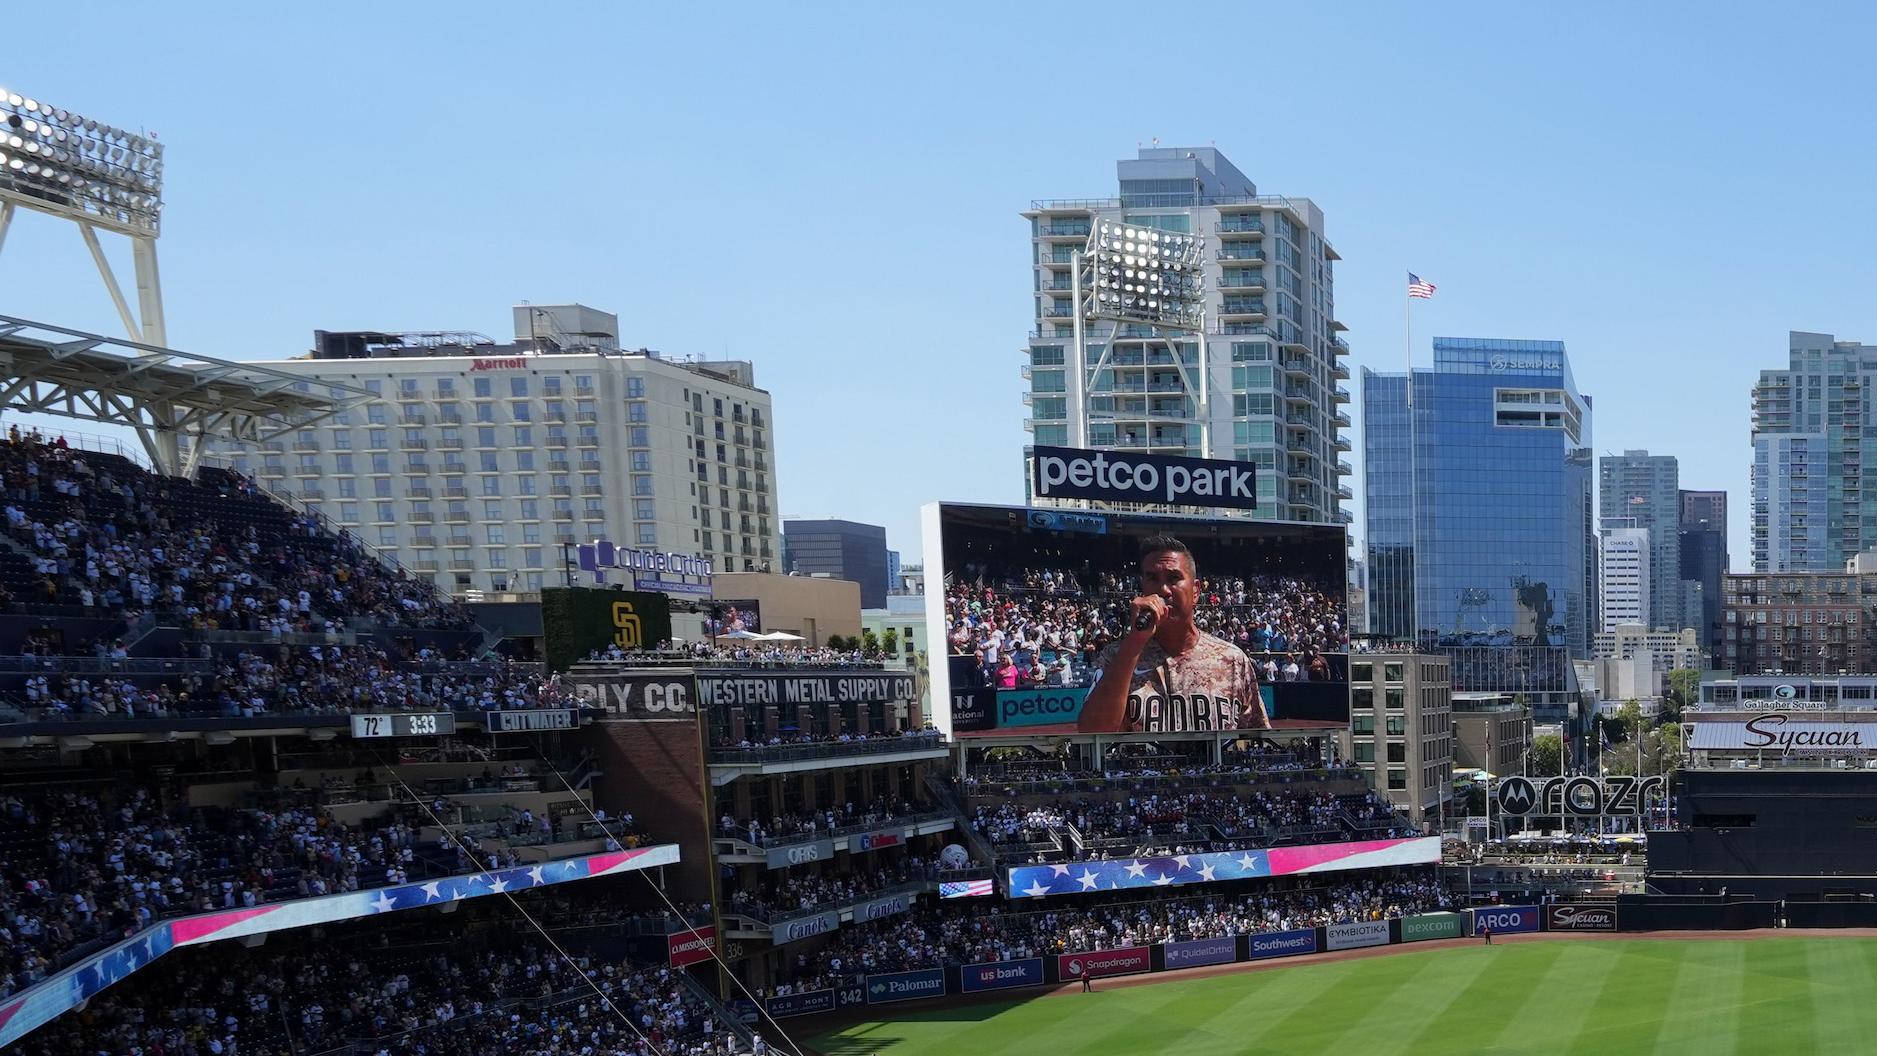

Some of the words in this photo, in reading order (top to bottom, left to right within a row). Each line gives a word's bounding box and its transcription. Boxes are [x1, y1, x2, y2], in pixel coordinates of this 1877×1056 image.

[470, 358, 527, 371] Marriott
[1510, 360, 1560, 369] SEMPRA
[1039, 453, 1159, 495] petco
[1166, 465, 1253, 502] park
[644, 683, 695, 713] CO.
[697, 678, 778, 705] WESTERN
[785, 678, 835, 701] METAL
[838, 678, 889, 700] SUPPLY
[895, 678, 917, 700] CO.
[953, 709, 985, 719] ational
[1002, 693, 1076, 723] petco
[1744, 700, 1790, 711] Gallagher
[1793, 700, 1827, 711] Square
[363, 717, 384, 736] 72°
[409, 715, 437, 735] 3:33
[501, 711, 572, 731] CUTWATER
[1744, 713, 1863, 757] Sycuan
[1540, 775, 1664, 817] razr
[1476, 913, 1521, 929] ARCO
[1553, 907, 1609, 929] Sycuan
[1253, 938, 1305, 952] Southwest
[1086, 955, 1142, 970] Snapdragon
[997, 965, 1026, 980] bank
[888, 978, 943, 993] Palomar
[840, 988, 863, 1005] 342
